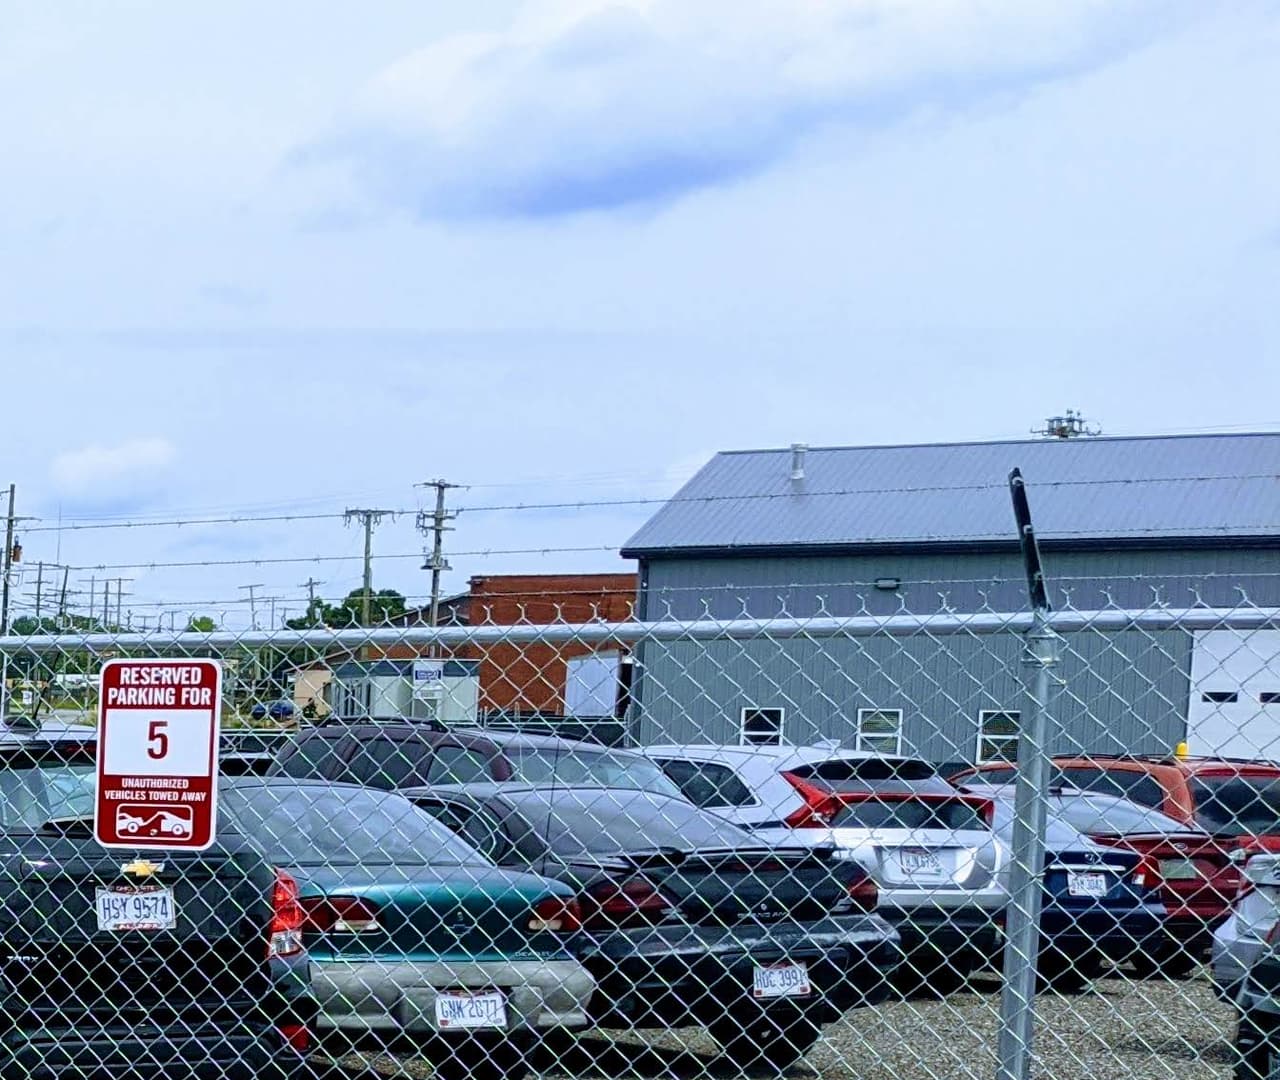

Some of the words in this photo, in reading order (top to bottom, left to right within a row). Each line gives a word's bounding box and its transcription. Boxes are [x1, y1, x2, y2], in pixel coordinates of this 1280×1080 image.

[120, 666, 202, 685] RESERVED
[107, 687, 176, 705] PARKING
[181, 687, 212, 705] FOR
[147, 721, 168, 759] 5
[121, 778, 189, 789] UNAUTHORIZED
[104, 790, 146, 800] VEHICLES
[148, 791, 179, 801] TOWED
[181, 792, 207, 801] AWAY
[102, 897, 128, 919] HSY
[133, 896, 168, 918] 9574
